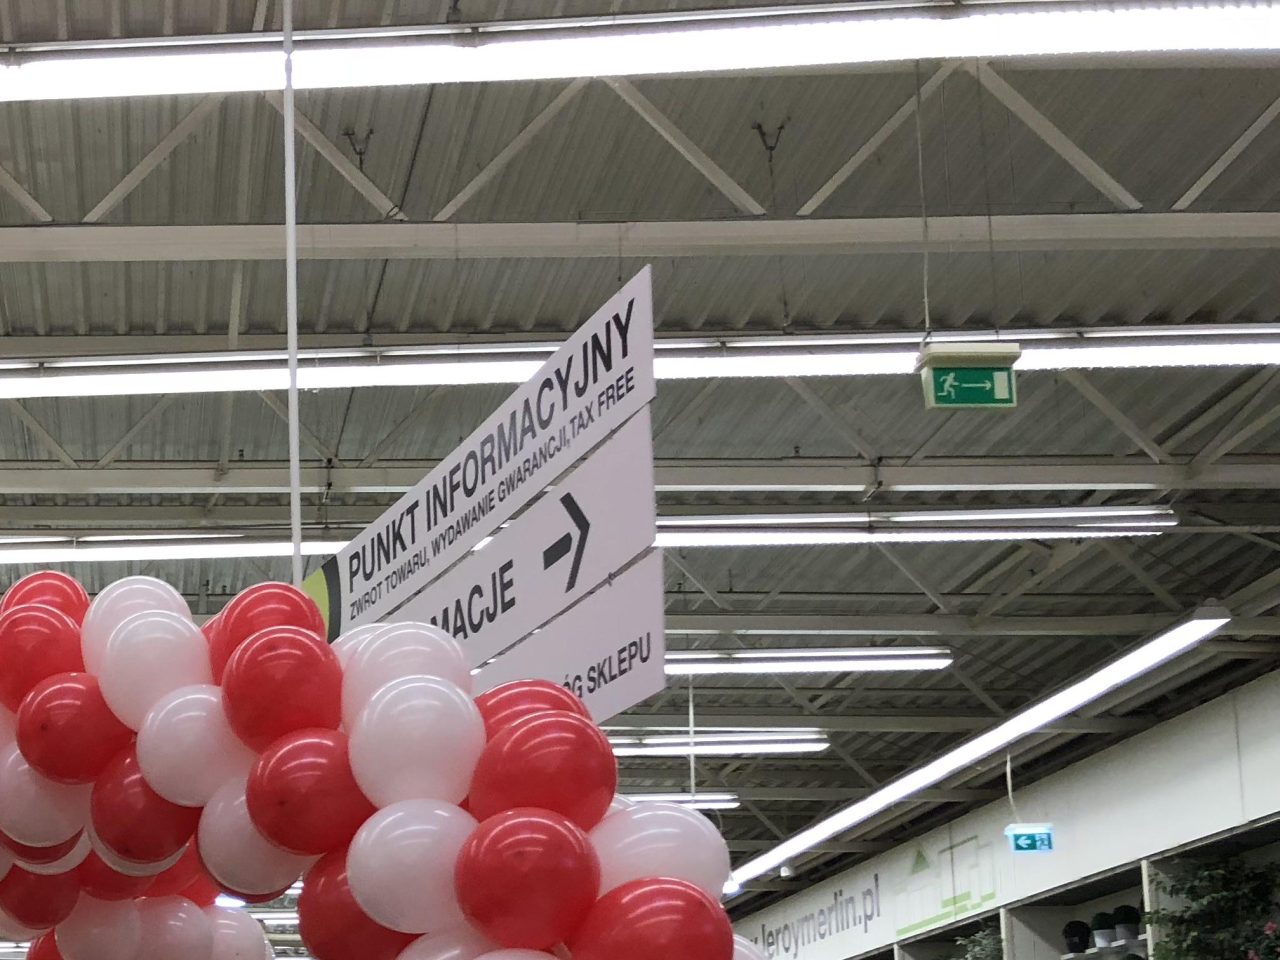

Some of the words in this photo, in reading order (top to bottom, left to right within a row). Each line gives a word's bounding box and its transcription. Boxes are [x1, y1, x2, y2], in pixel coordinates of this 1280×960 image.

[349, 500, 419, 594] PUNKT
[426, 297, 635, 532] INFORMACYJNY
[350, 581, 382, 621] ZWROT
[385, 546, 430, 594] TOWARU,
[431, 489, 495, 557] WYDAWANIE
[498, 425, 570, 503] GWARANCJI,
[570, 400, 595, 439] TAX
[598, 366, 635, 417] FREE
[587, 631, 651, 694] SKLEPU
[750, 873, 881, 959] leroymerlin.pl
